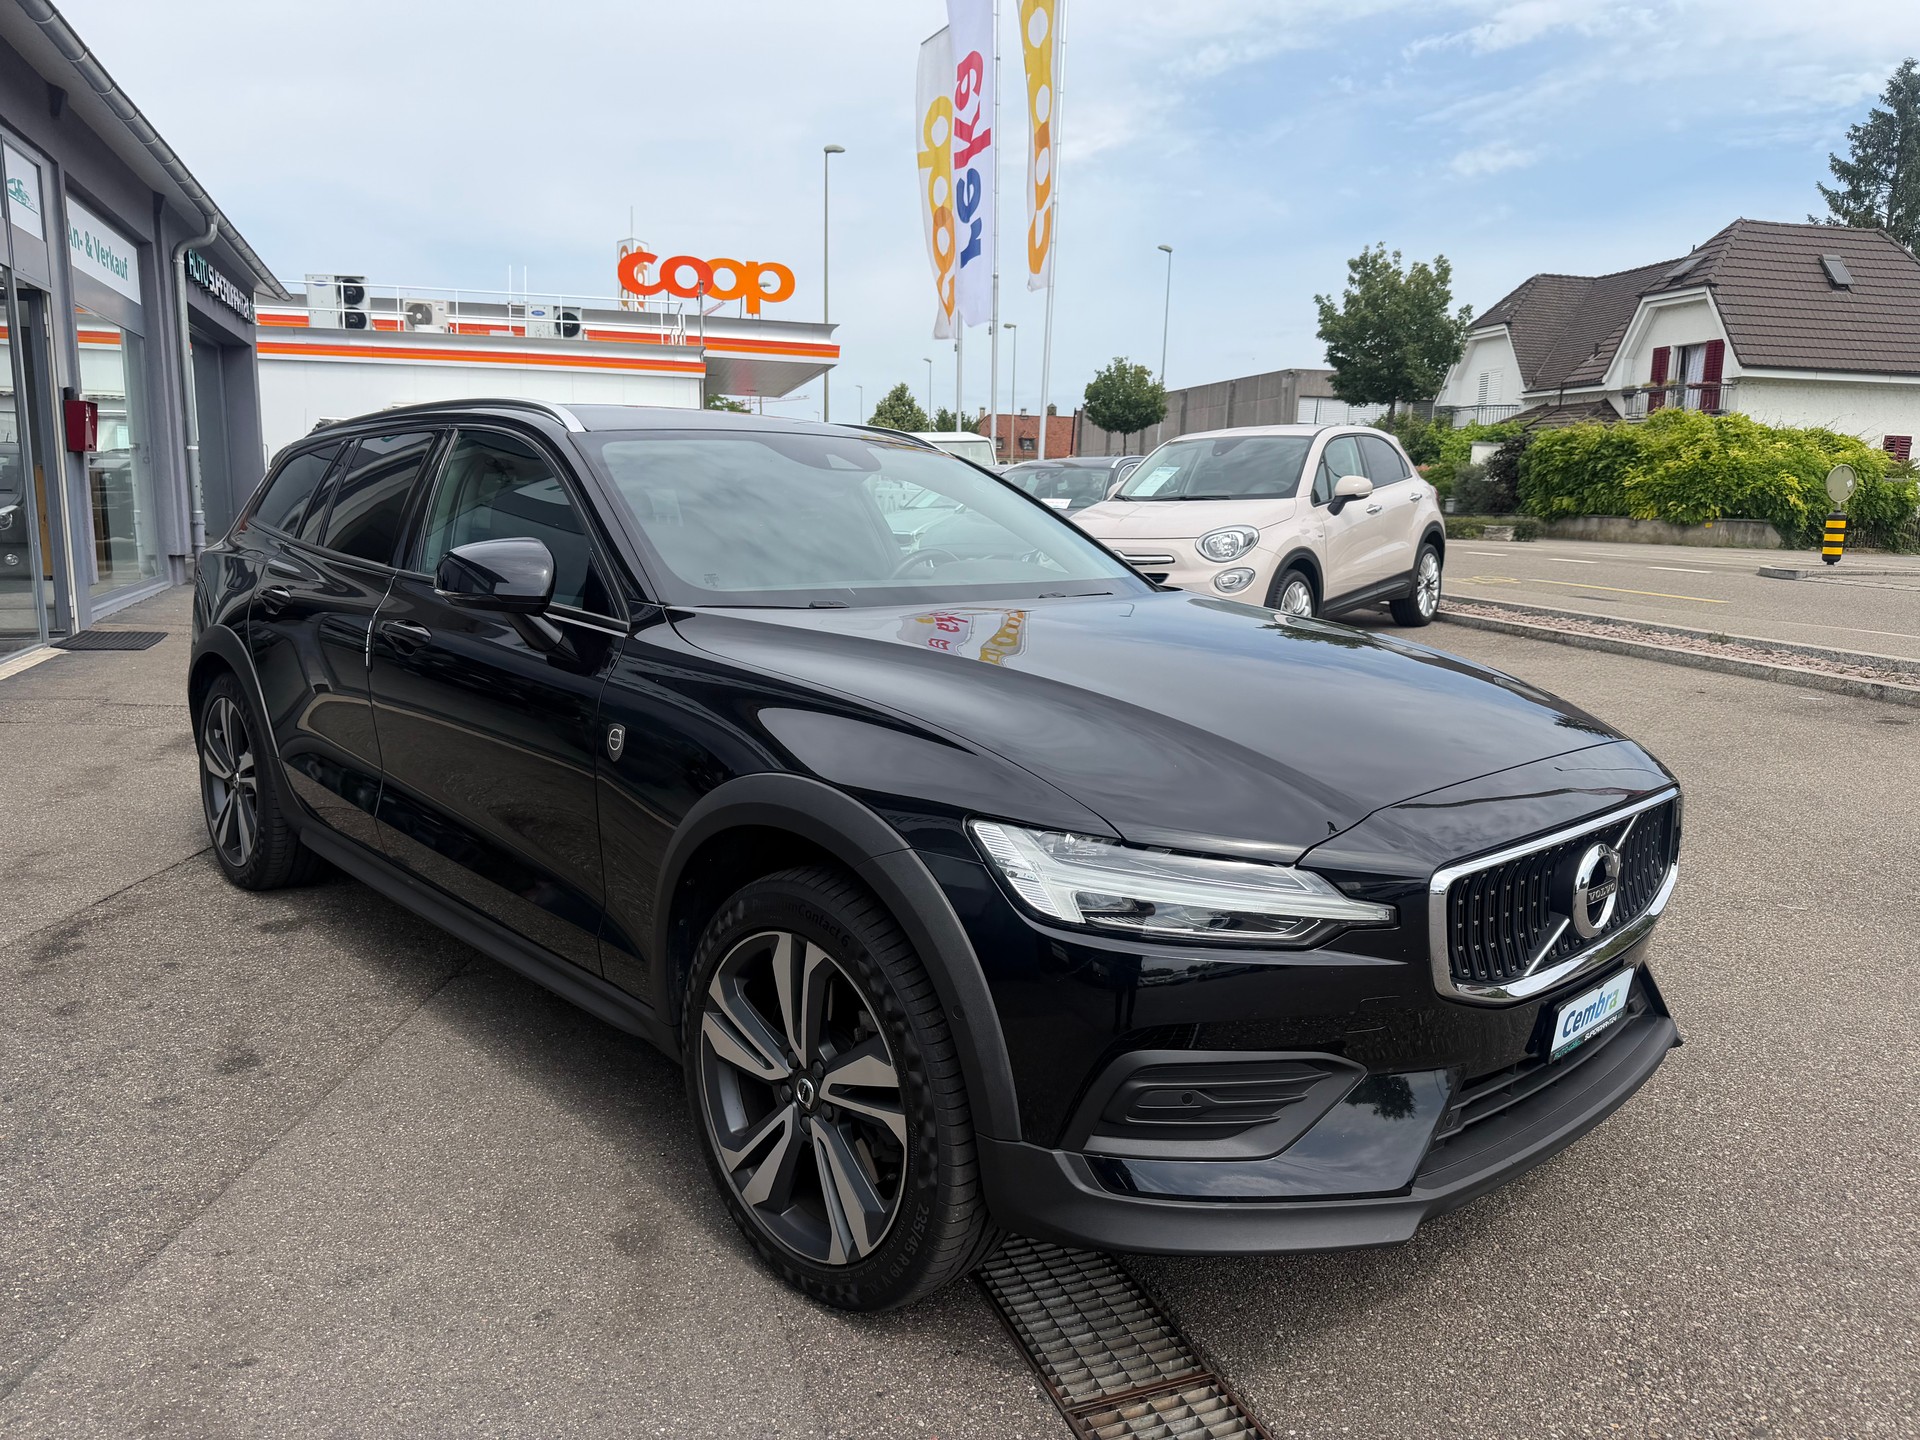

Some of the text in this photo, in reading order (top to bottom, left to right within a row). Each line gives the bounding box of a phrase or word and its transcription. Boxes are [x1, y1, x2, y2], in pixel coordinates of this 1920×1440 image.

[85, 231, 93, 259] &
[93, 236, 128, 281] Verkauf
[618, 252, 795, 314] coop
[1588, 882, 1616, 901] VOLVO
[841, 934, 850, 948] 6
[1562, 989, 1619, 1038] Cembra
[904, 1201, 929, 1255] 235/45
